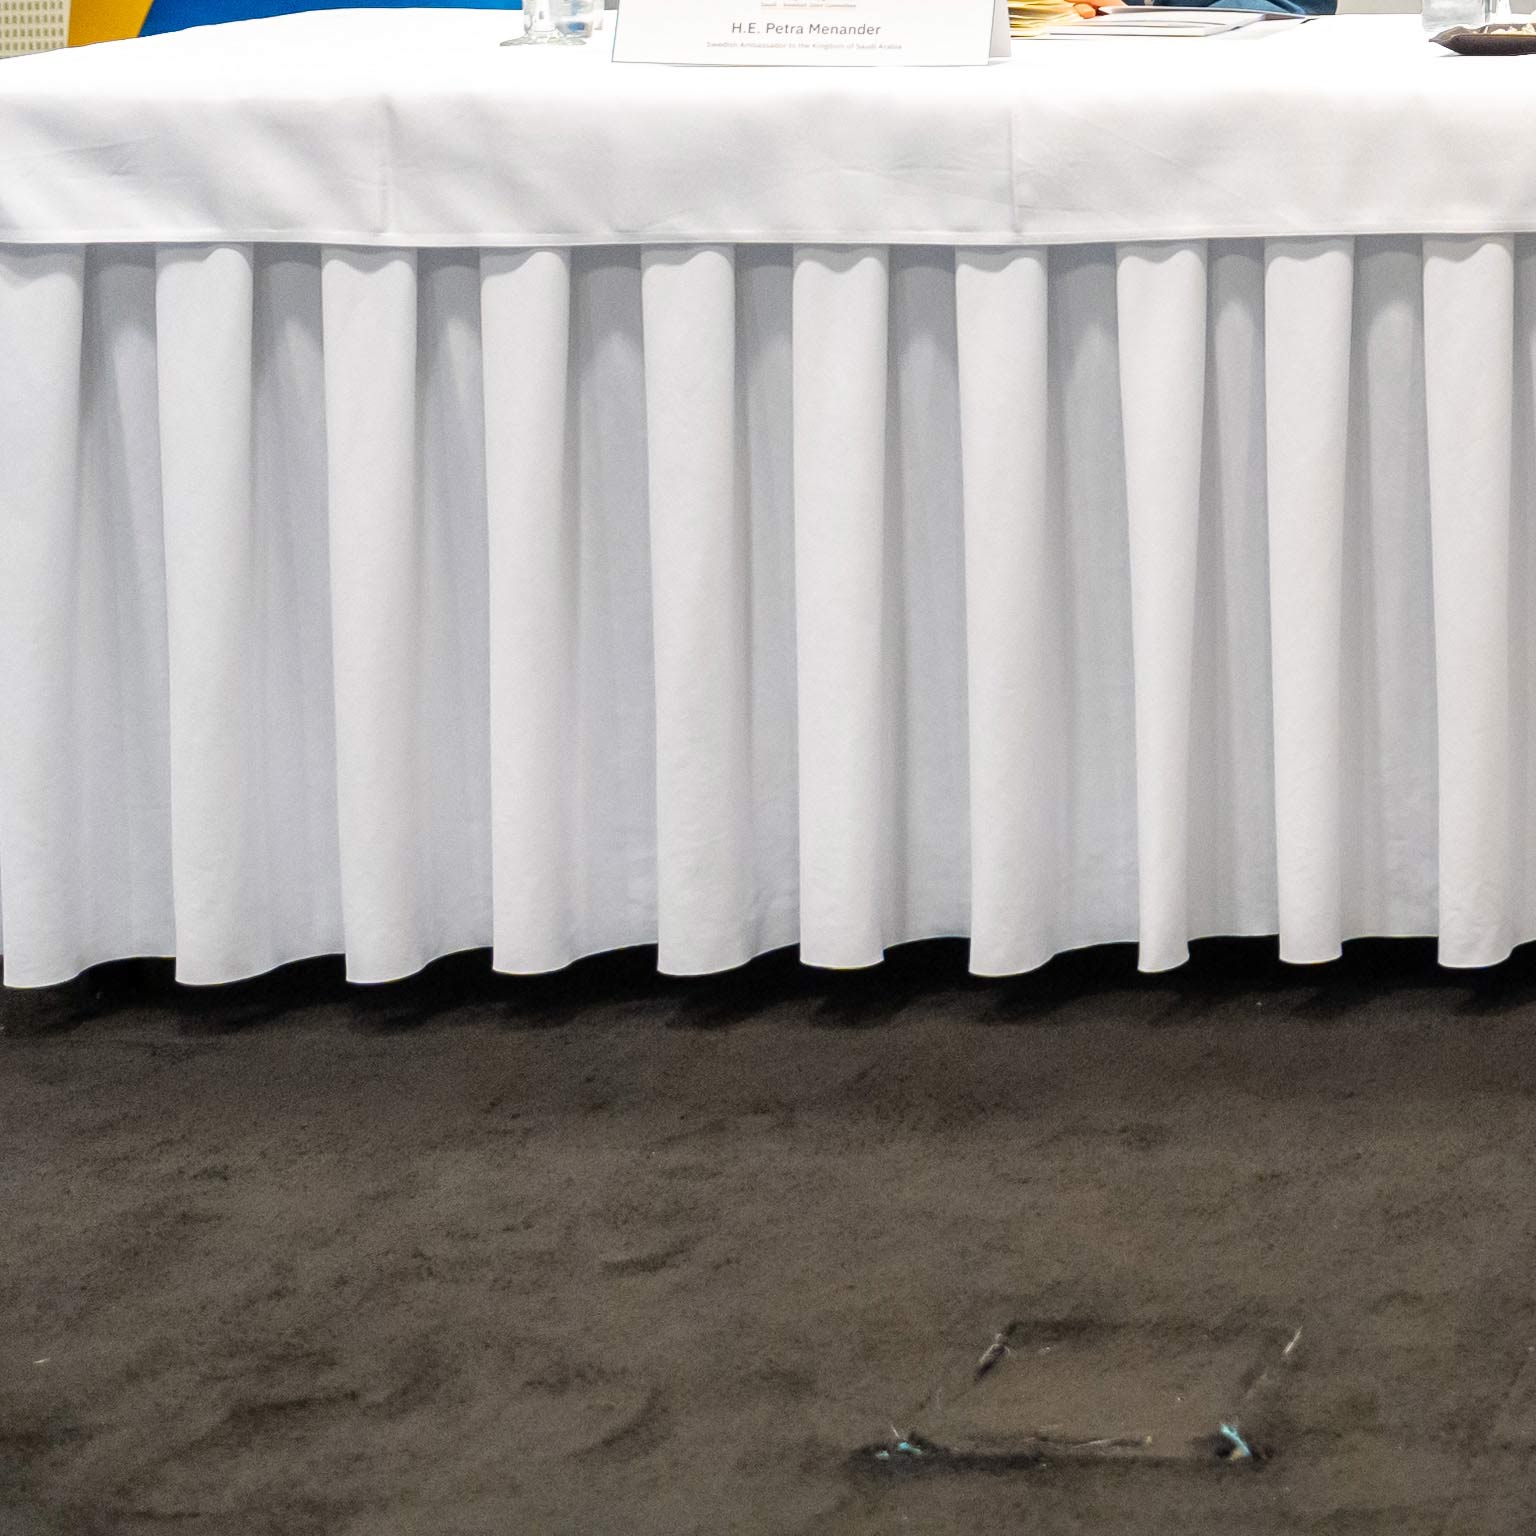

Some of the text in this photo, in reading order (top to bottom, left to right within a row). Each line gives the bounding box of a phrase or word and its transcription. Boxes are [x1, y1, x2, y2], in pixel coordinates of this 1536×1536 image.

[731, 21, 882, 36] H.E. Petra Menander
